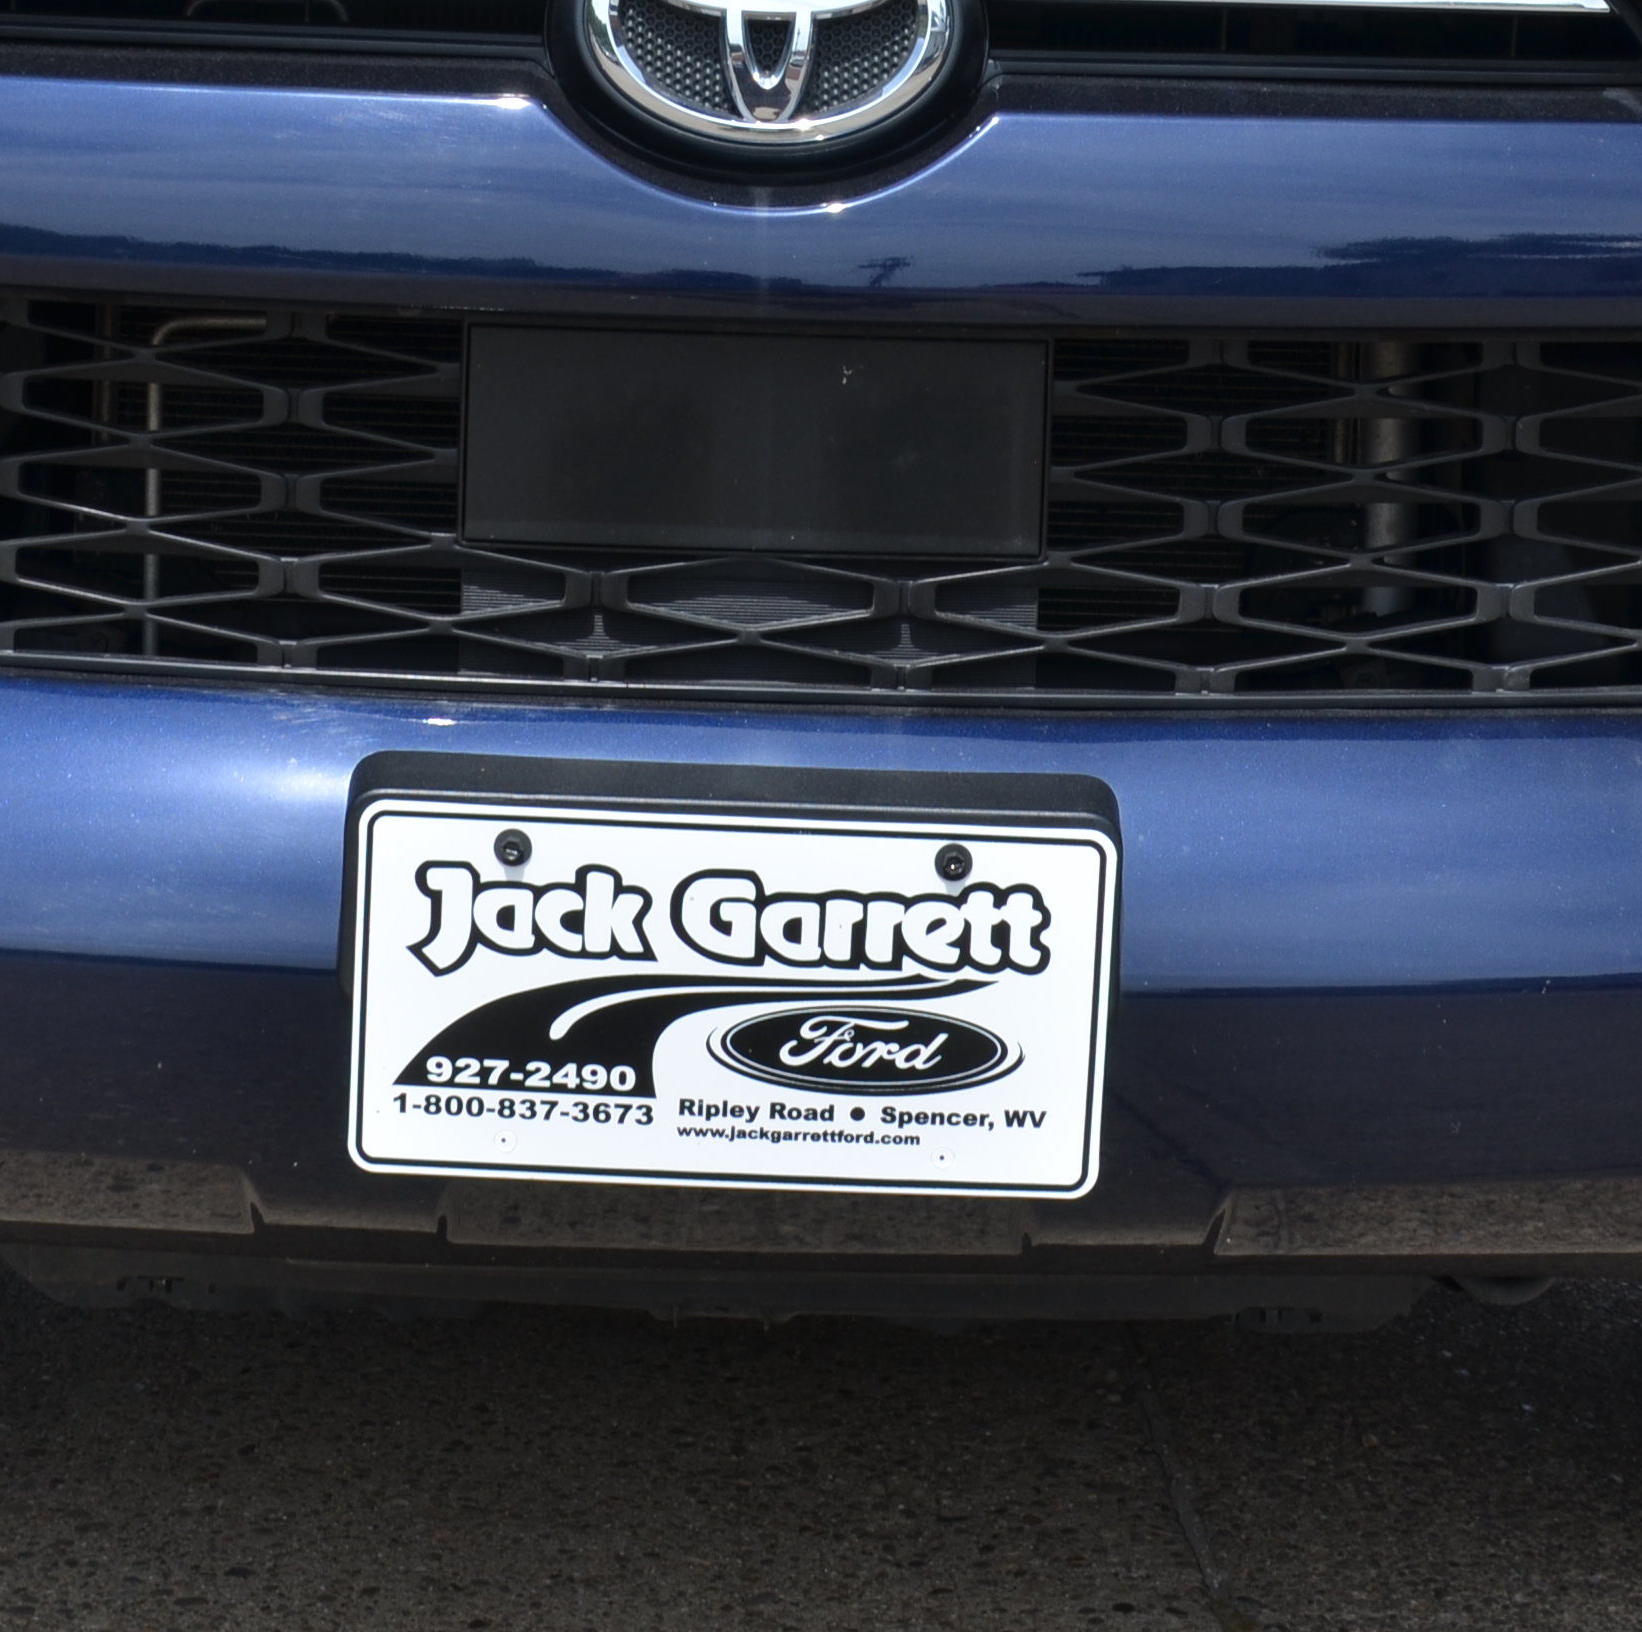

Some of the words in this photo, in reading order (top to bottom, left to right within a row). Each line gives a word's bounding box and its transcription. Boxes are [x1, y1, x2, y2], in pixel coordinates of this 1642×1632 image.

[407, 861, 658, 977] Jack
[670, 869, 1052, 976] Garrett
[779, 1015, 949, 1070] Ford
[425, 1055, 637, 1092] 927-2490
[393, 1093, 655, 1126] 1-800-837-3673
[678, 1098, 761, 1124] Ripley
[769, 1103, 836, 1123] Road
[880, 1106, 994, 1132] Spencer,
[1004, 1110, 1048, 1129] WV
[677, 1127, 921, 1146] www.jackgarrettford.com
